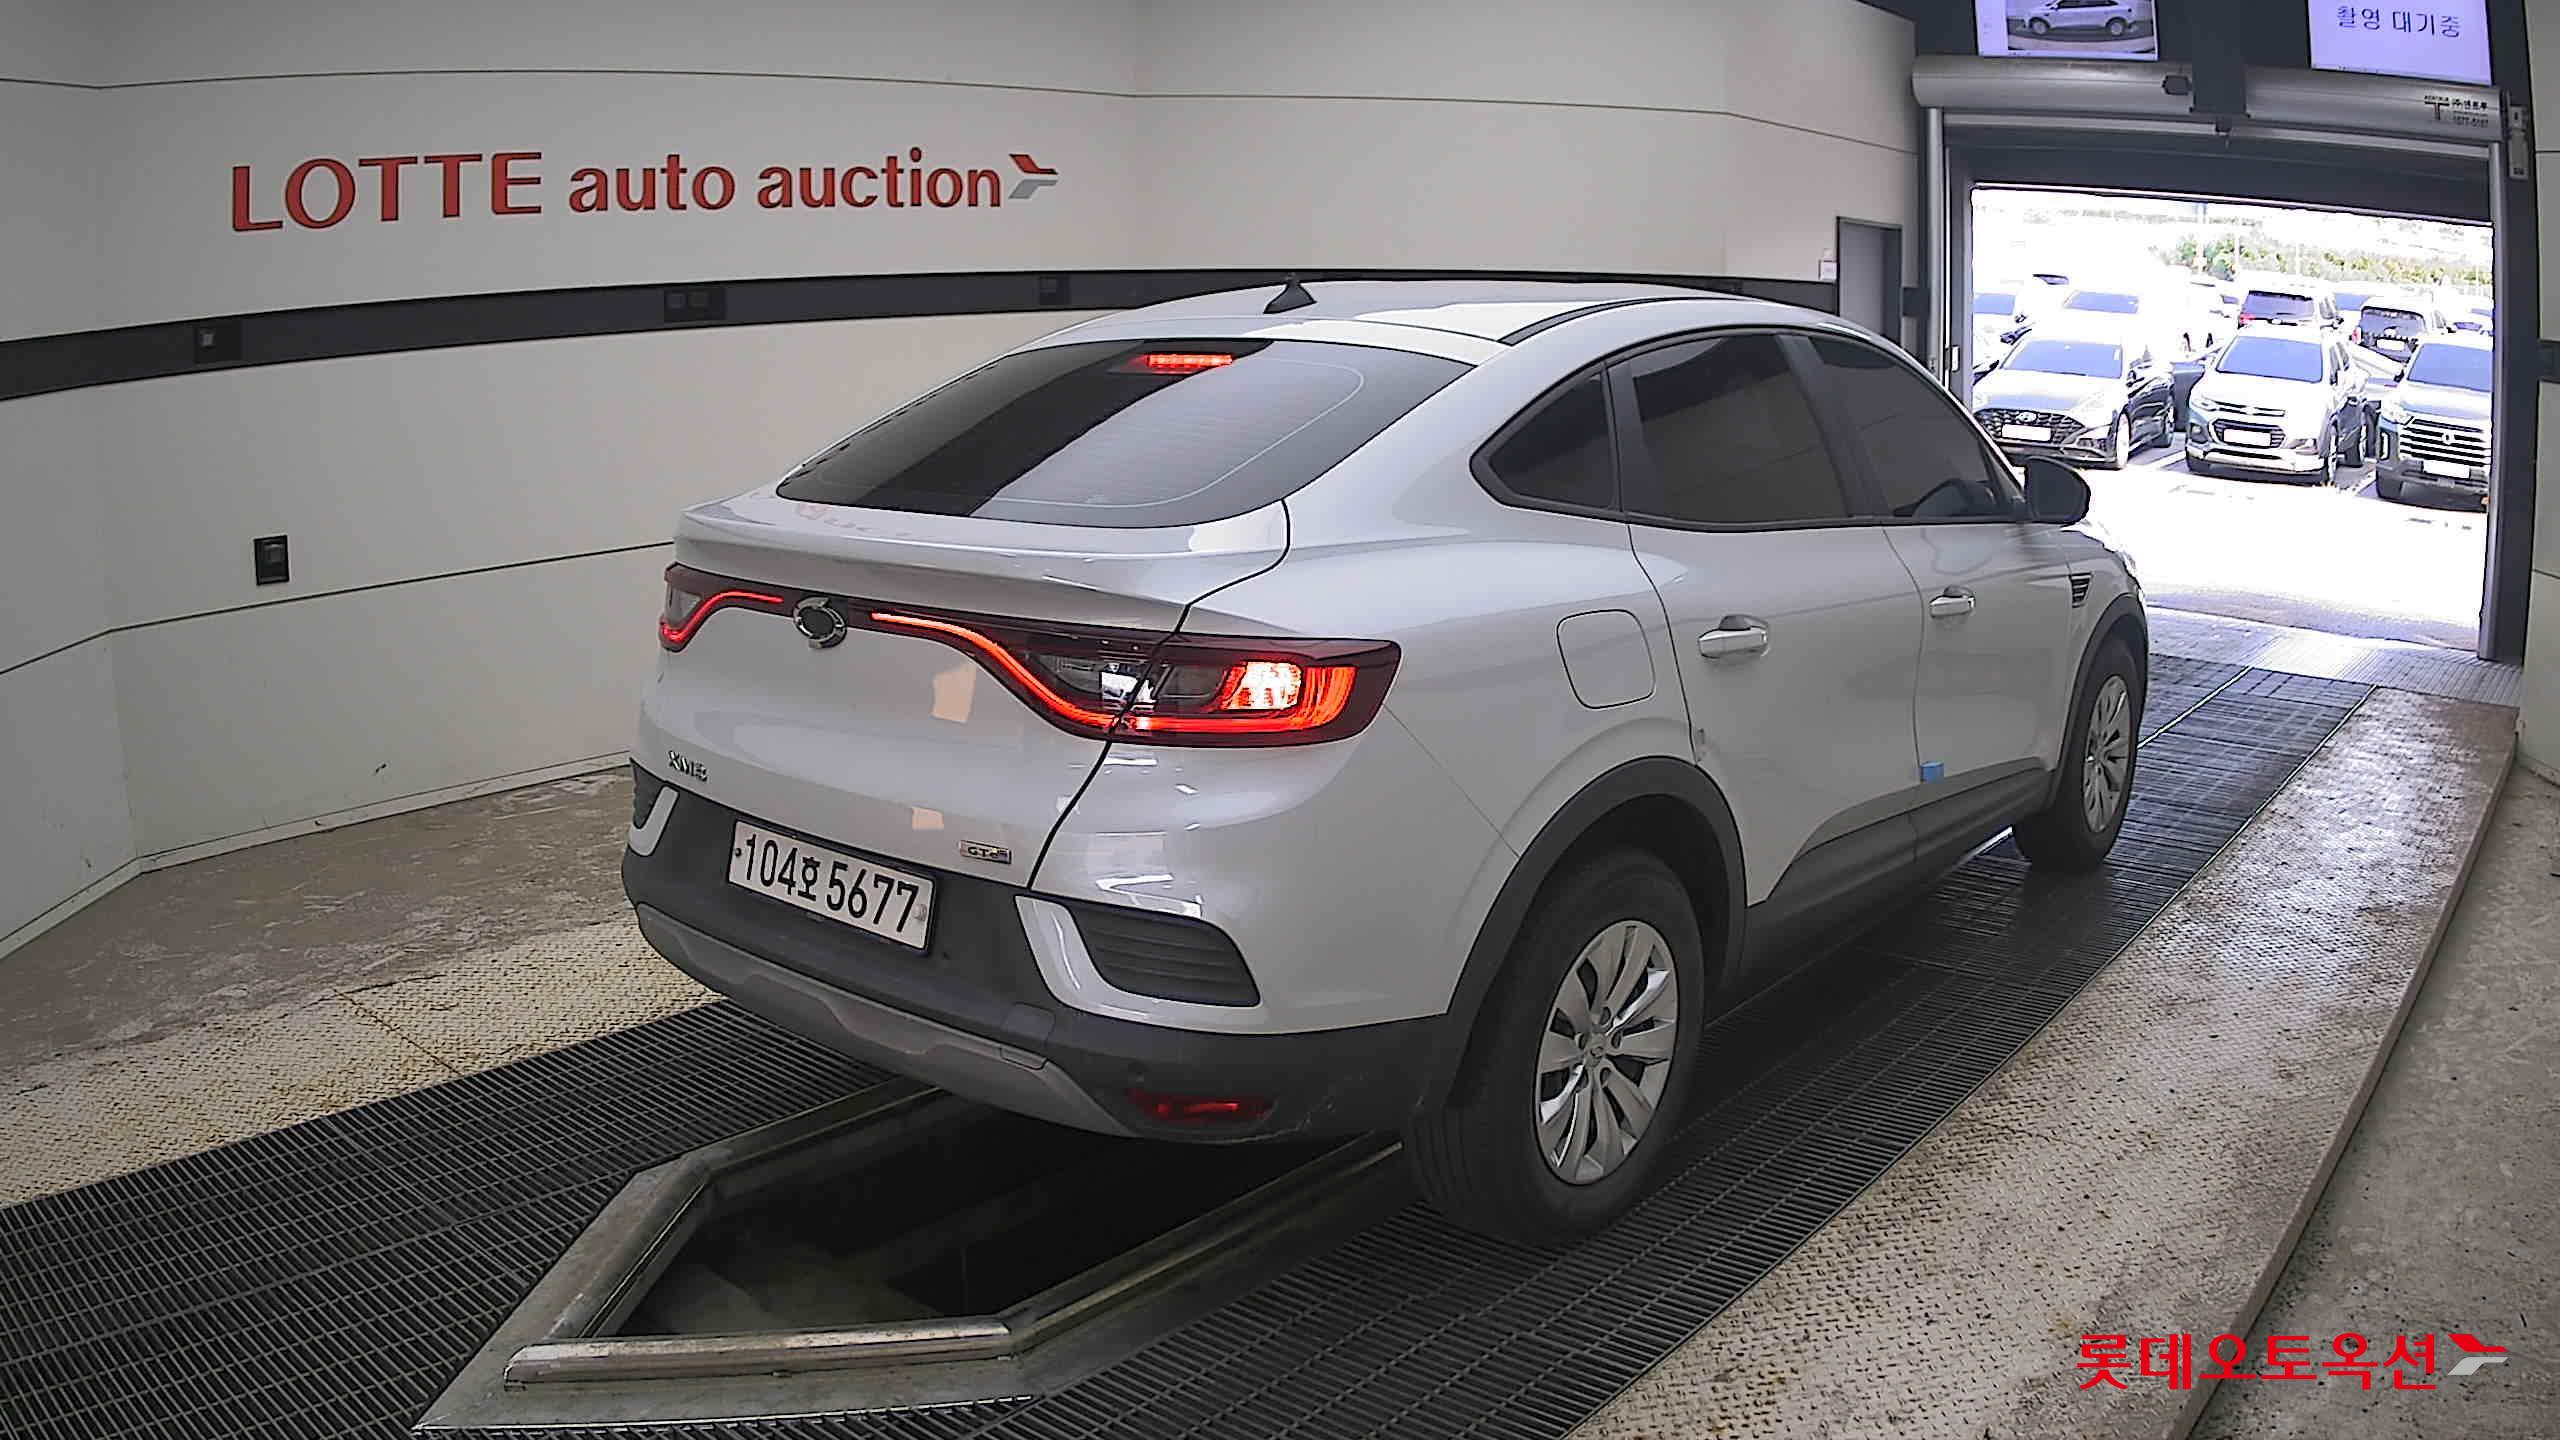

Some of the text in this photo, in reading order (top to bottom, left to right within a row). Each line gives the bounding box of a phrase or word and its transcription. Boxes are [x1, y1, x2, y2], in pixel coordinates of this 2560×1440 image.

[2337, 5, 2461, 38] 촬영 대기중
[231, 146, 1001, 232] LOTTE auto auction
[826, 860, 920, 933] 5677
